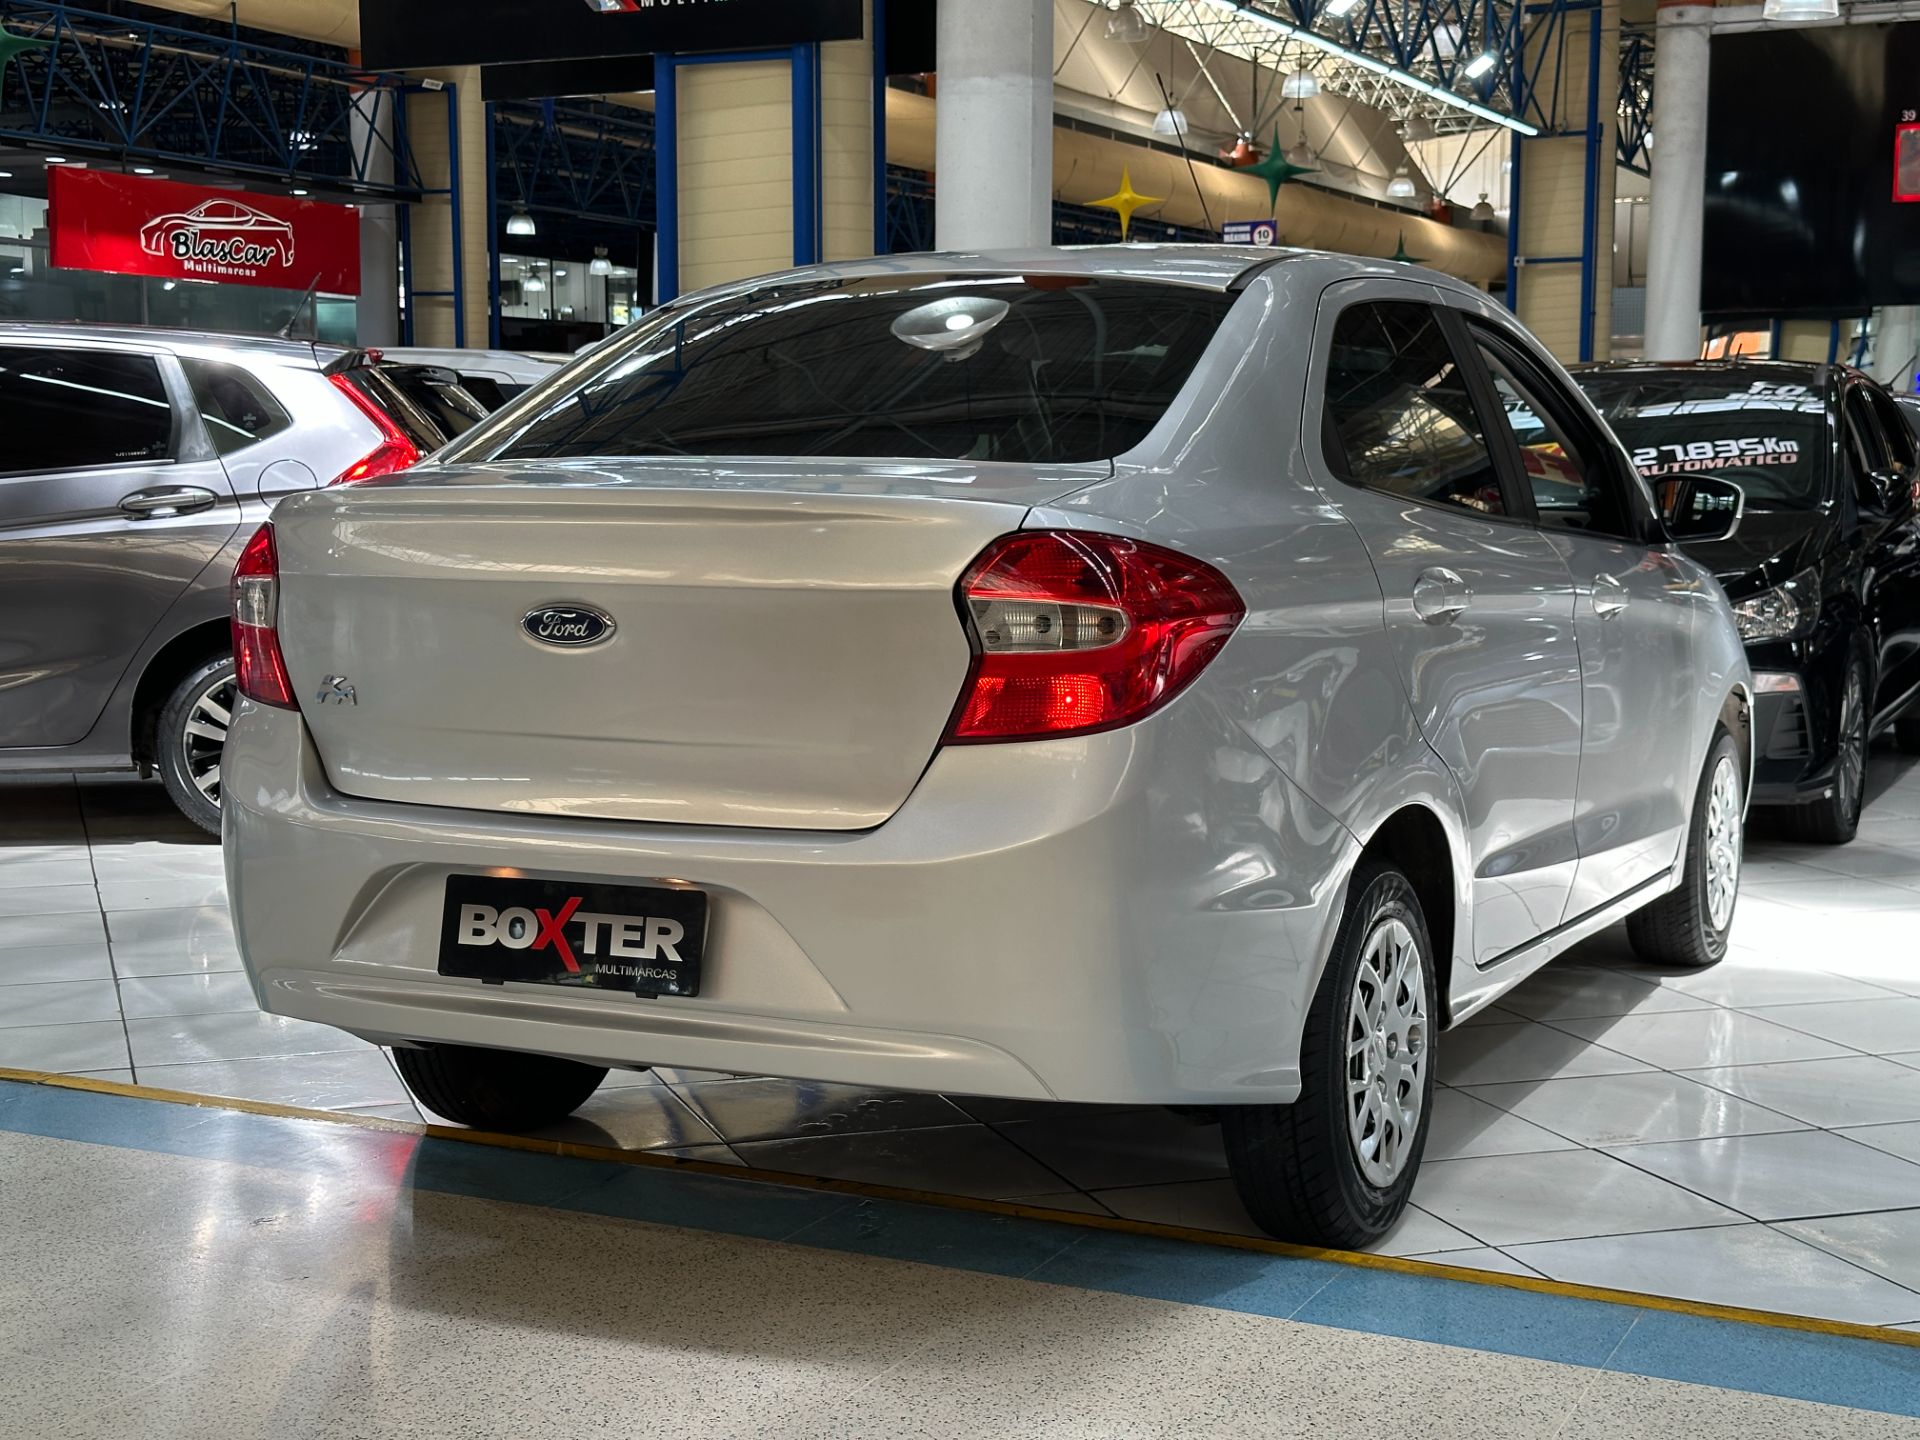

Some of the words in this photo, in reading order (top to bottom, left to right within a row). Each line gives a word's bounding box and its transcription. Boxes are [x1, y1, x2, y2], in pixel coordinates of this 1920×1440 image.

[1901, 109, 1917, 121] 39
[1257, 229, 1269, 239] 10
[170, 229, 275, 267] BlasCar
[184, 260, 256, 277] Multimarcas
[1637, 453, 1798, 477] AUTOMATICO
[538, 611, 589, 637] Ford
[457, 896, 683, 973] BOXTER
[595, 962, 678, 980] MULTIMARCAS
